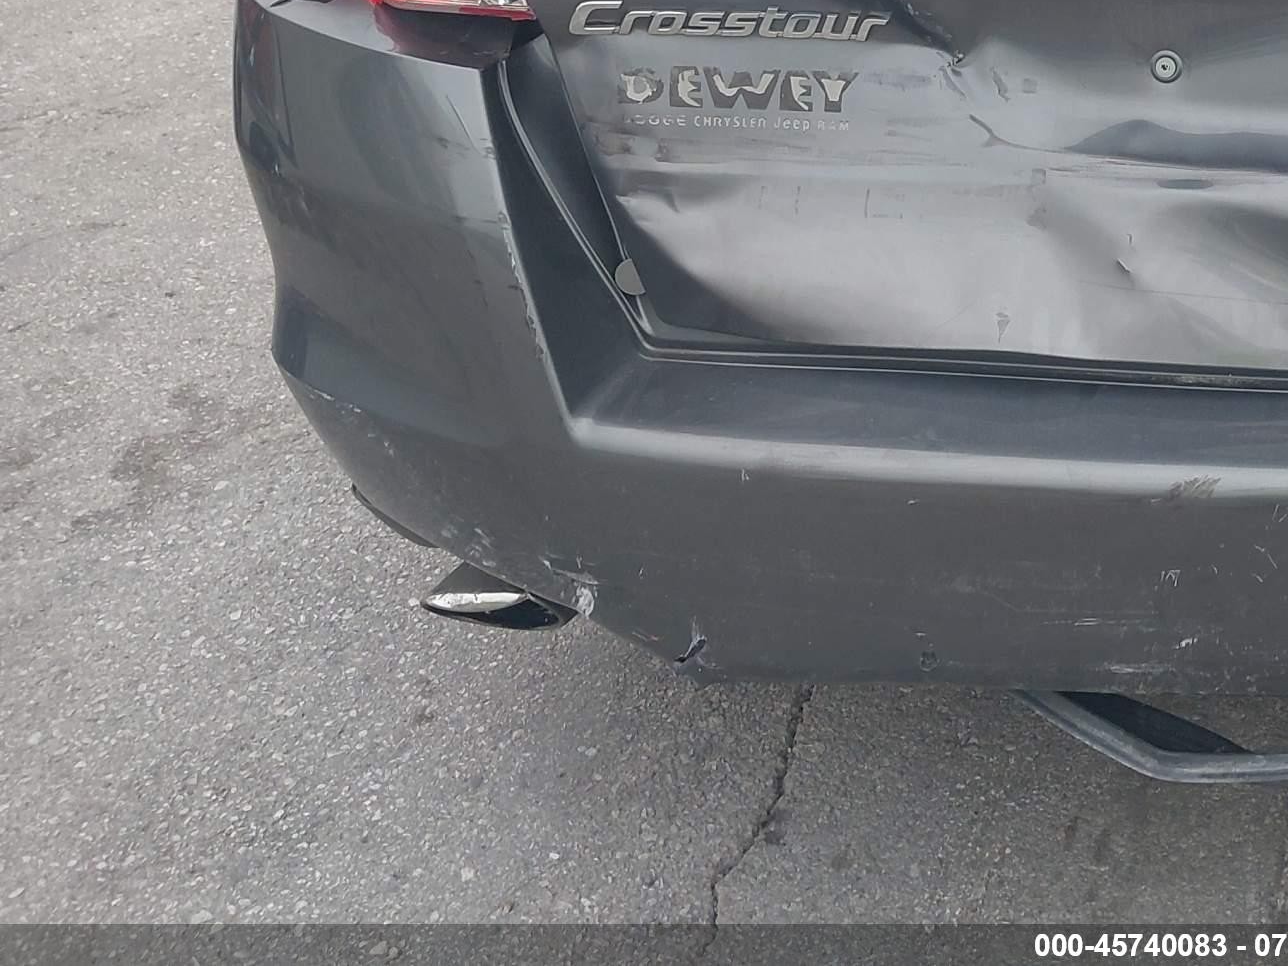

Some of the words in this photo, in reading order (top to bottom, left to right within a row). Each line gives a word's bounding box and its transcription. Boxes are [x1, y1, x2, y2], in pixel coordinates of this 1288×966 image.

[568, 0, 890, 42] Crosstour
[618, 65, 859, 112] DEWEY
[773, 119, 810, 132] Jeep
